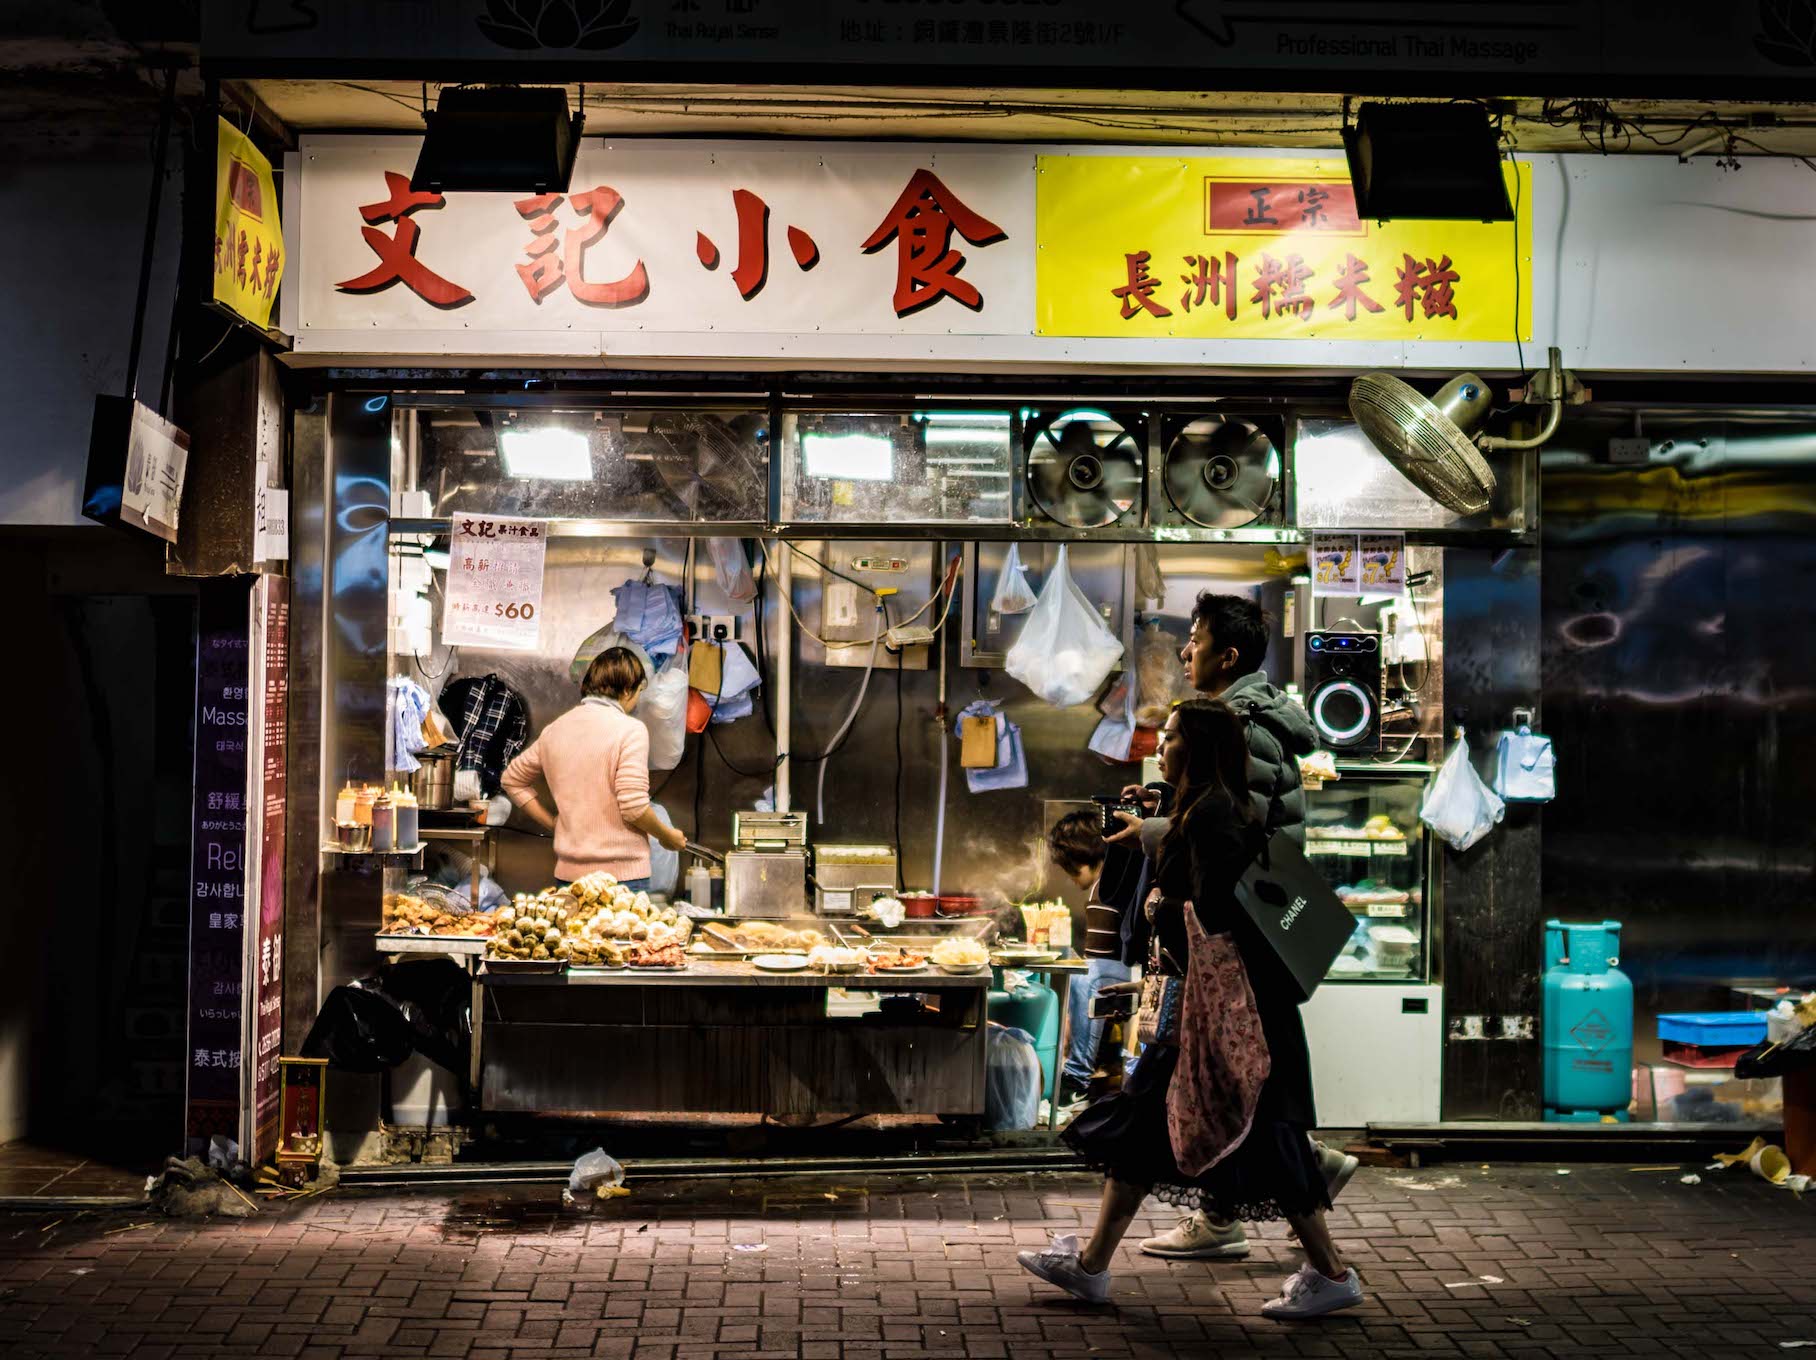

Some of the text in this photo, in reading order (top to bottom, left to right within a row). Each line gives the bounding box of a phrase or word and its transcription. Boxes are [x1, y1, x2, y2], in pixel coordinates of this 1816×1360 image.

[1276, 33, 1538, 64] Professional Thai Massage
[1243, 185, 1330, 228] 正宗
[335, 168, 1009, 319] 文記小食
[1111, 250, 1460, 322] 長洲糯米糍
[495, 602, 535, 620] $60
[208, 792, 246, 810] 舒緩
[209, 912, 244, 929] 皇家
[1280, 896, 1307, 930] CHANEL
